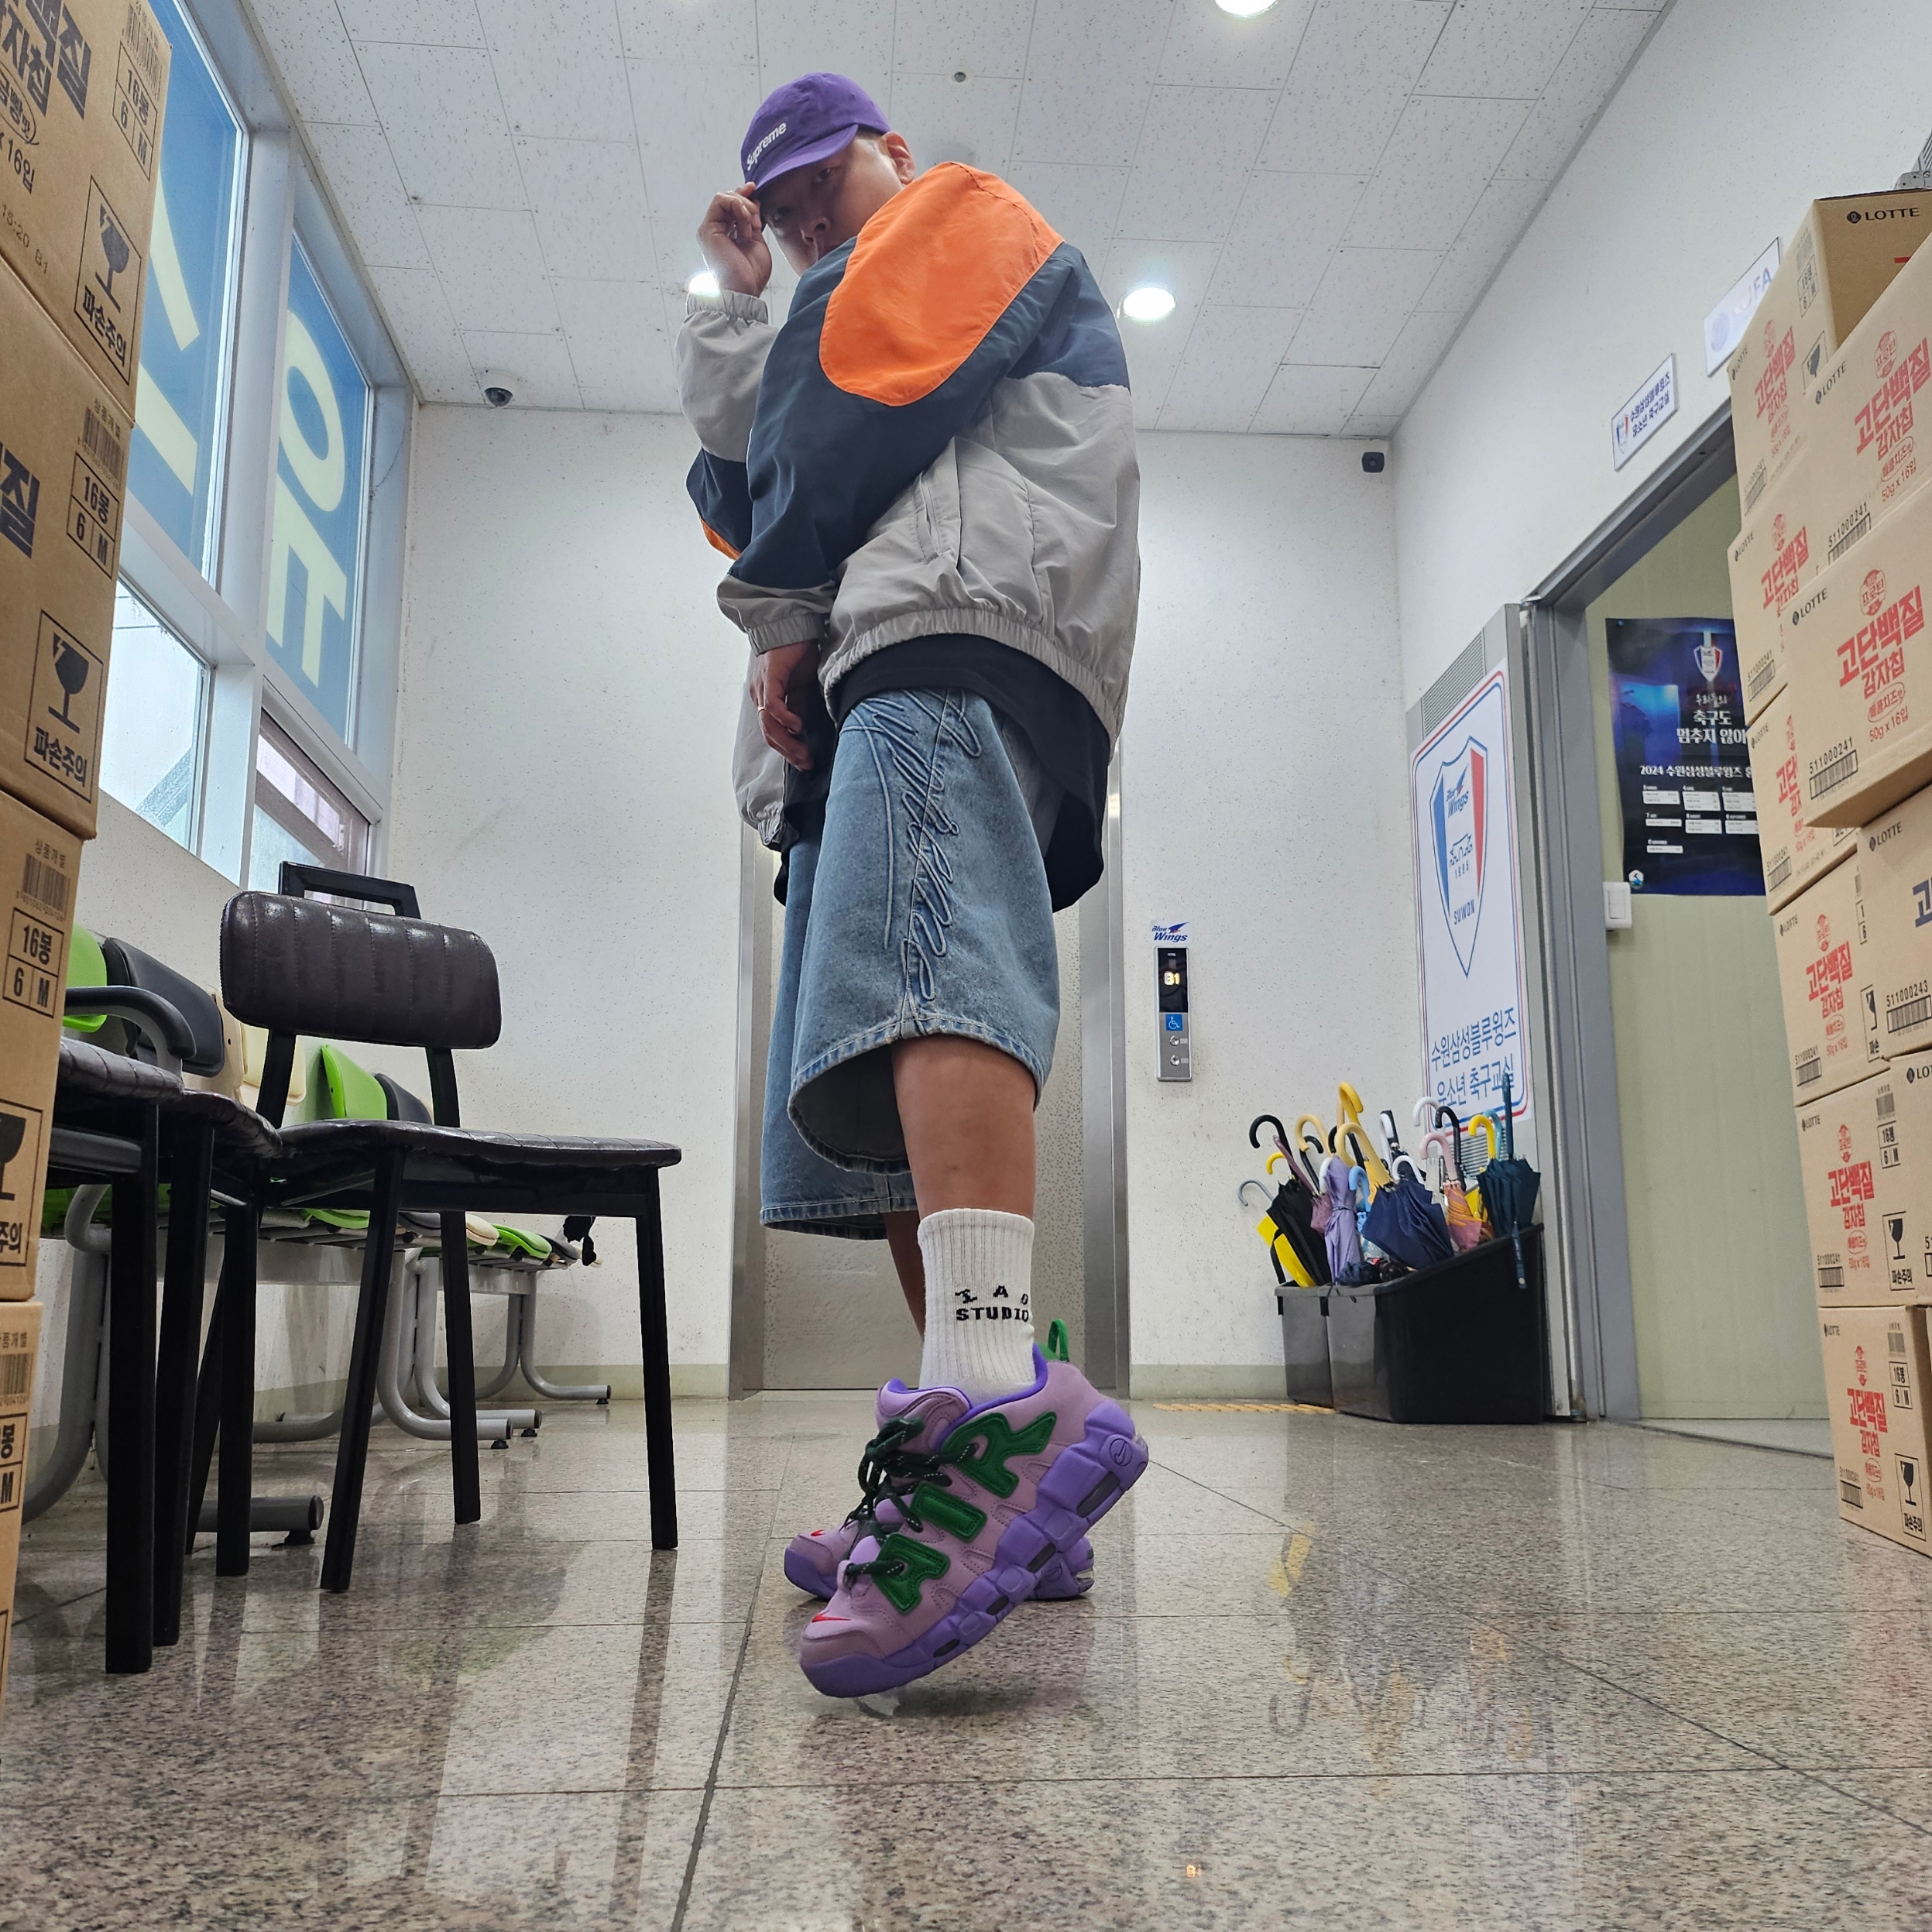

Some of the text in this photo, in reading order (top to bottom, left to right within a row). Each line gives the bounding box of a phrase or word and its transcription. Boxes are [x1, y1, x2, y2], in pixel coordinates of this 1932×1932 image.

[120, 101, 129, 129] 6
[127, 70, 149, 126] 16봉
[138, 132, 148, 166] M
[746, 122, 788, 171] Supreme
[8, 138, 36, 194] 16입
[1865, 207, 1921, 221] LOTTE
[82, 284, 127, 368] 파손주의
[1755, 325, 1796, 420] 고단백질
[1822, 360, 1848, 396] LOTTE
[1630, 371, 1671, 423] 수원삼성블루윙즈
[1855, 336, 1932, 455] 고단백질
[1875, 400, 1914, 462] 감자칩
[84, 476, 110, 525] 16봉
[76, 512, 87, 541] 6
[1827, 501, 1869, 548] 511000241
[98, 533, 108, 566] M
[1760, 525, 1810, 611] 고단백질
[1798, 587, 1828, 619] LOTTE
[1836, 584, 1926, 688] 고단백질
[1861, 646, 1906, 700] 감자칩
[1693, 709, 1733, 726] 축구도
[1869, 726, 1885, 743] 50g
[1891, 705, 1909, 728] 16입
[1676, 728, 1718, 744] 멈추지
[33, 726, 88, 788] 파손주의
[1639, 764, 1664, 775] 2024
[1666, 764, 1743, 778] 수원삼성블루윙즈
[1808, 736, 1854, 775] 511000241
[1776, 753, 1799, 805] 고단
[1447, 791, 1470, 818] Wings
[1876, 821, 1903, 846] LOTTE
[1454, 860, 1470, 880] 1995
[1453, 898, 1475, 925] SUWON
[1913, 877, 1932, 928] 고
[22, 925, 52, 966] 16봉
[1154, 932, 1189, 943] Wings
[13, 967, 25, 997] 6
[1805, 940, 1854, 1002] 고단백질
[36, 977, 50, 1008] M
[1820, 986, 1844, 1020] 감자칩
[1886, 980, 1929, 1007] 511000243
[1431, 1007, 1517, 1072] 수원삼성블루윙즈
[1869, 1038, 1880, 1056] 파손
[1436, 1052, 1515, 1107] 유소년 축구교실
[1806, 1115, 1820, 1129] LOTTE
[1882, 1125, 1896, 1144] 16봉
[1883, 1150, 1889, 1165] 6
[1827, 1160, 1875, 1208] 고단백질
[1842, 1203, 1866, 1230] 감자칩
[1891, 1267, 1913, 1285] 파손주의
[956, 1306, 1029, 1323] STUDIO
[1846, 1388, 1888, 1434] 고단백질
[0, 1422, 15, 1460] 봉
[1859, 1429, 1881, 1458] 감자칩
[873, 1411, 1058, 1615] AIR
[1903, 1512, 1923, 1534] 파손주의
